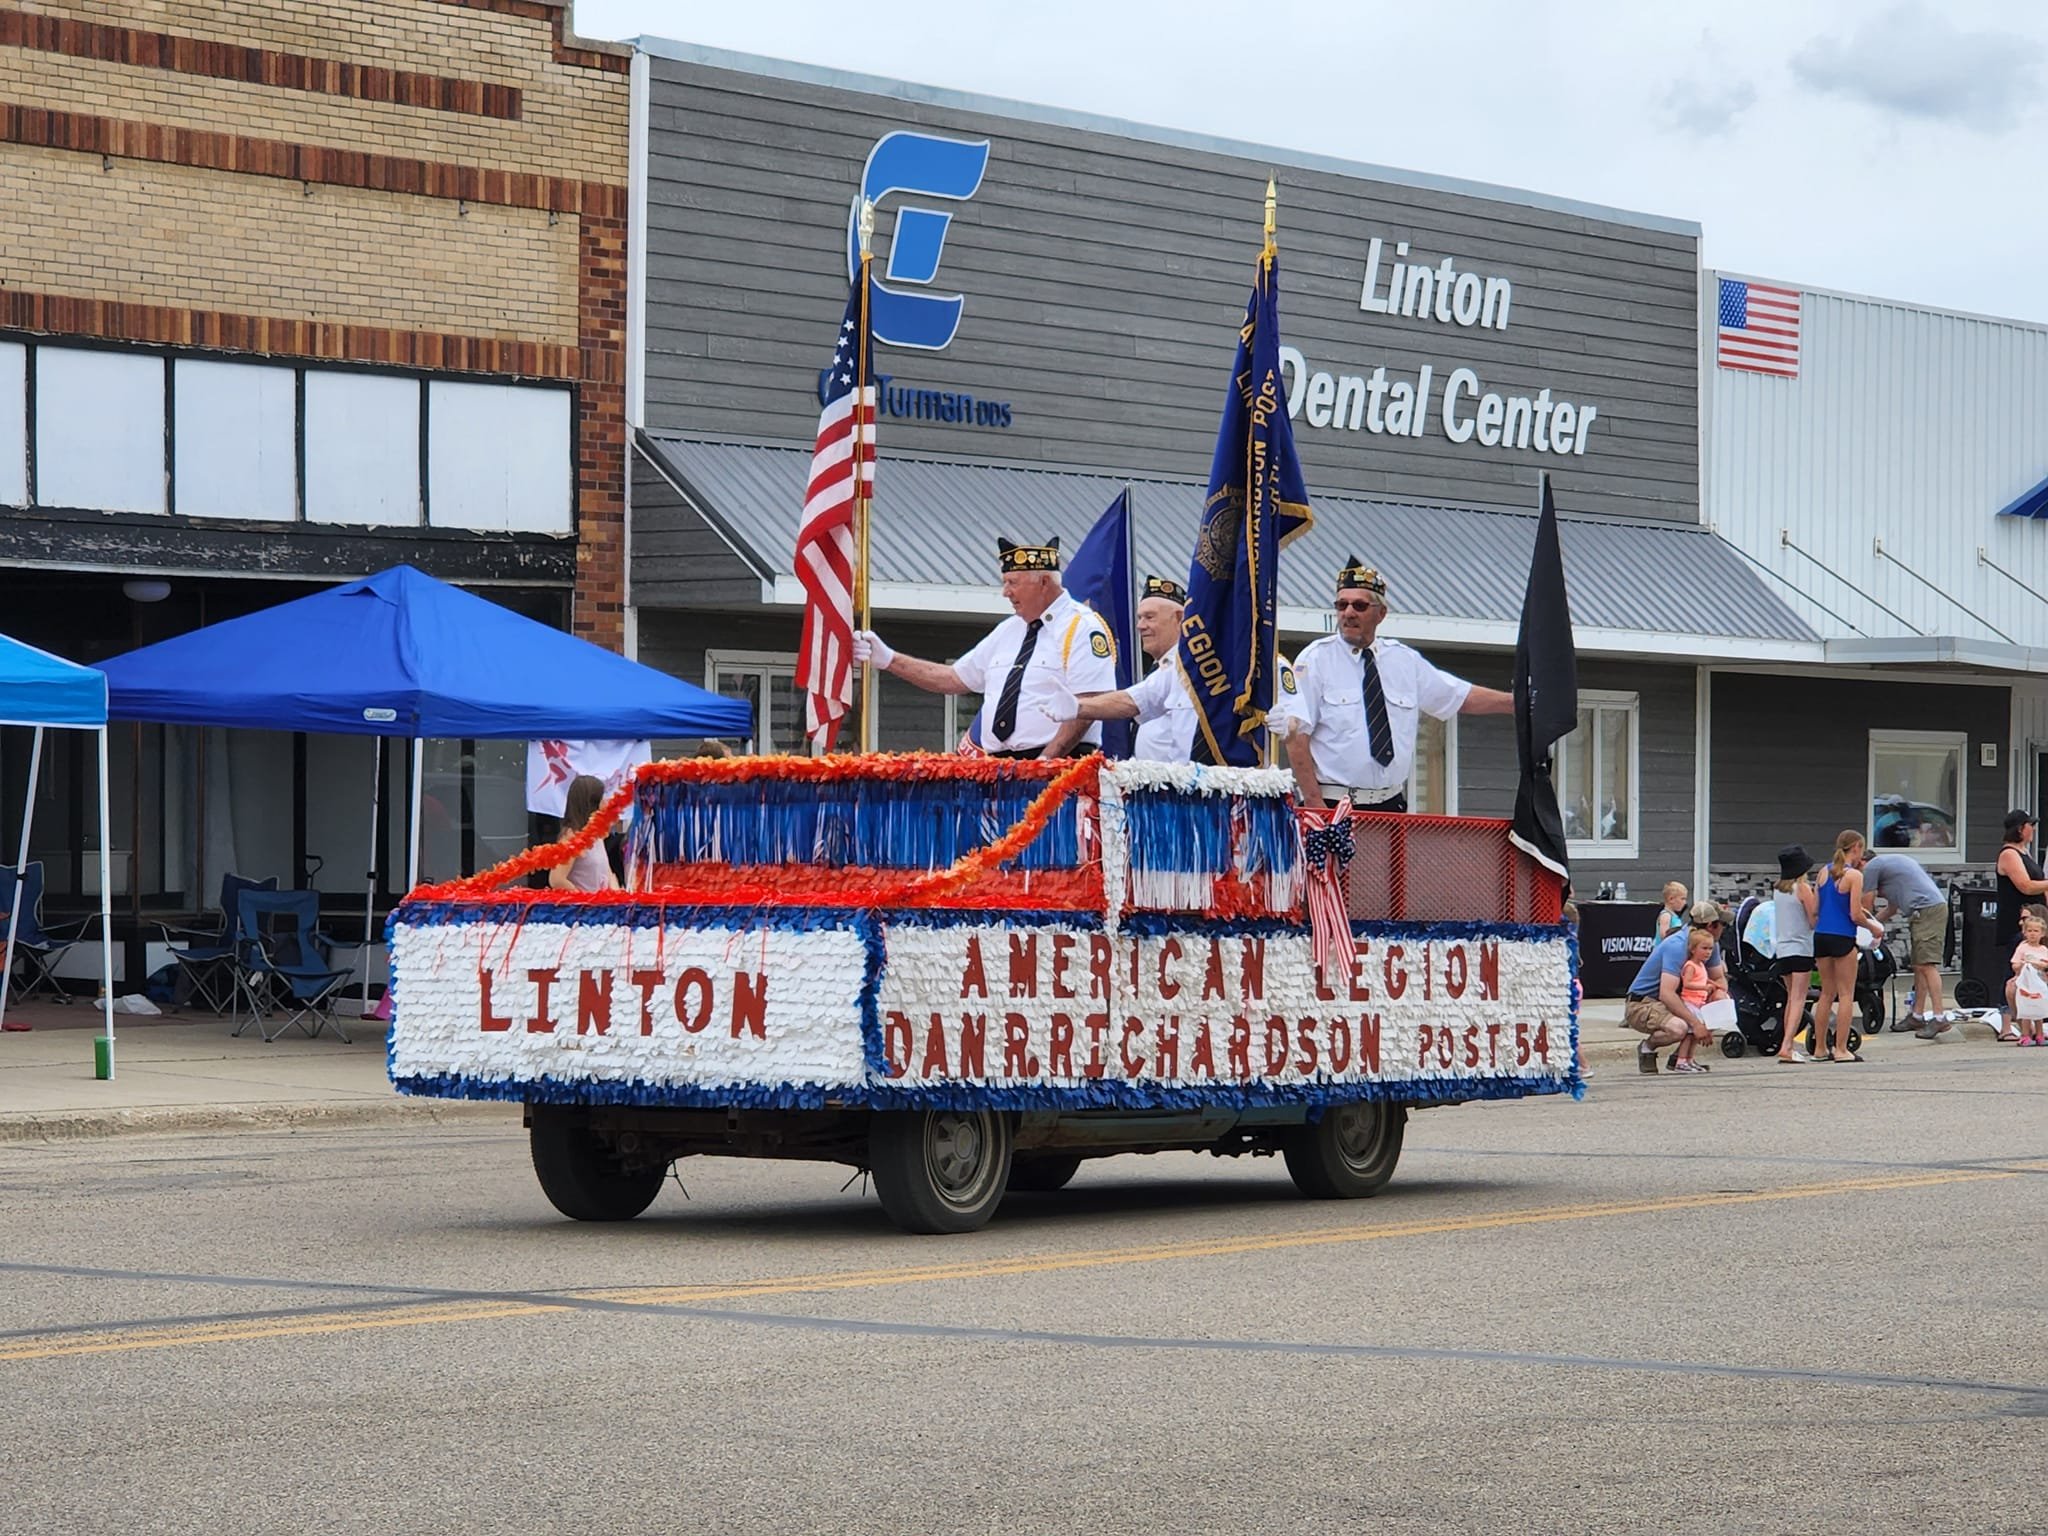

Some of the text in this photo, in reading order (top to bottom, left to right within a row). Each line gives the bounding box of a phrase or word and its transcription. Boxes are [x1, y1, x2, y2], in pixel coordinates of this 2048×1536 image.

[1360, 237, 1511, 330] Linton
[874, 374, 974, 424] Turman
[975, 400, 1013, 428] DDS
[1278, 345, 1597, 455] Dental Center
[1181, 613, 1232, 697] EGION
[960, 933, 1499, 1001] AMERICAN LEGION
[1633, 936, 1654, 953] ZER
[479, 967, 768, 1040] LINTON
[1418, 1023, 1500, 1069] POST
[1515, 1020, 1550, 1067] 54
